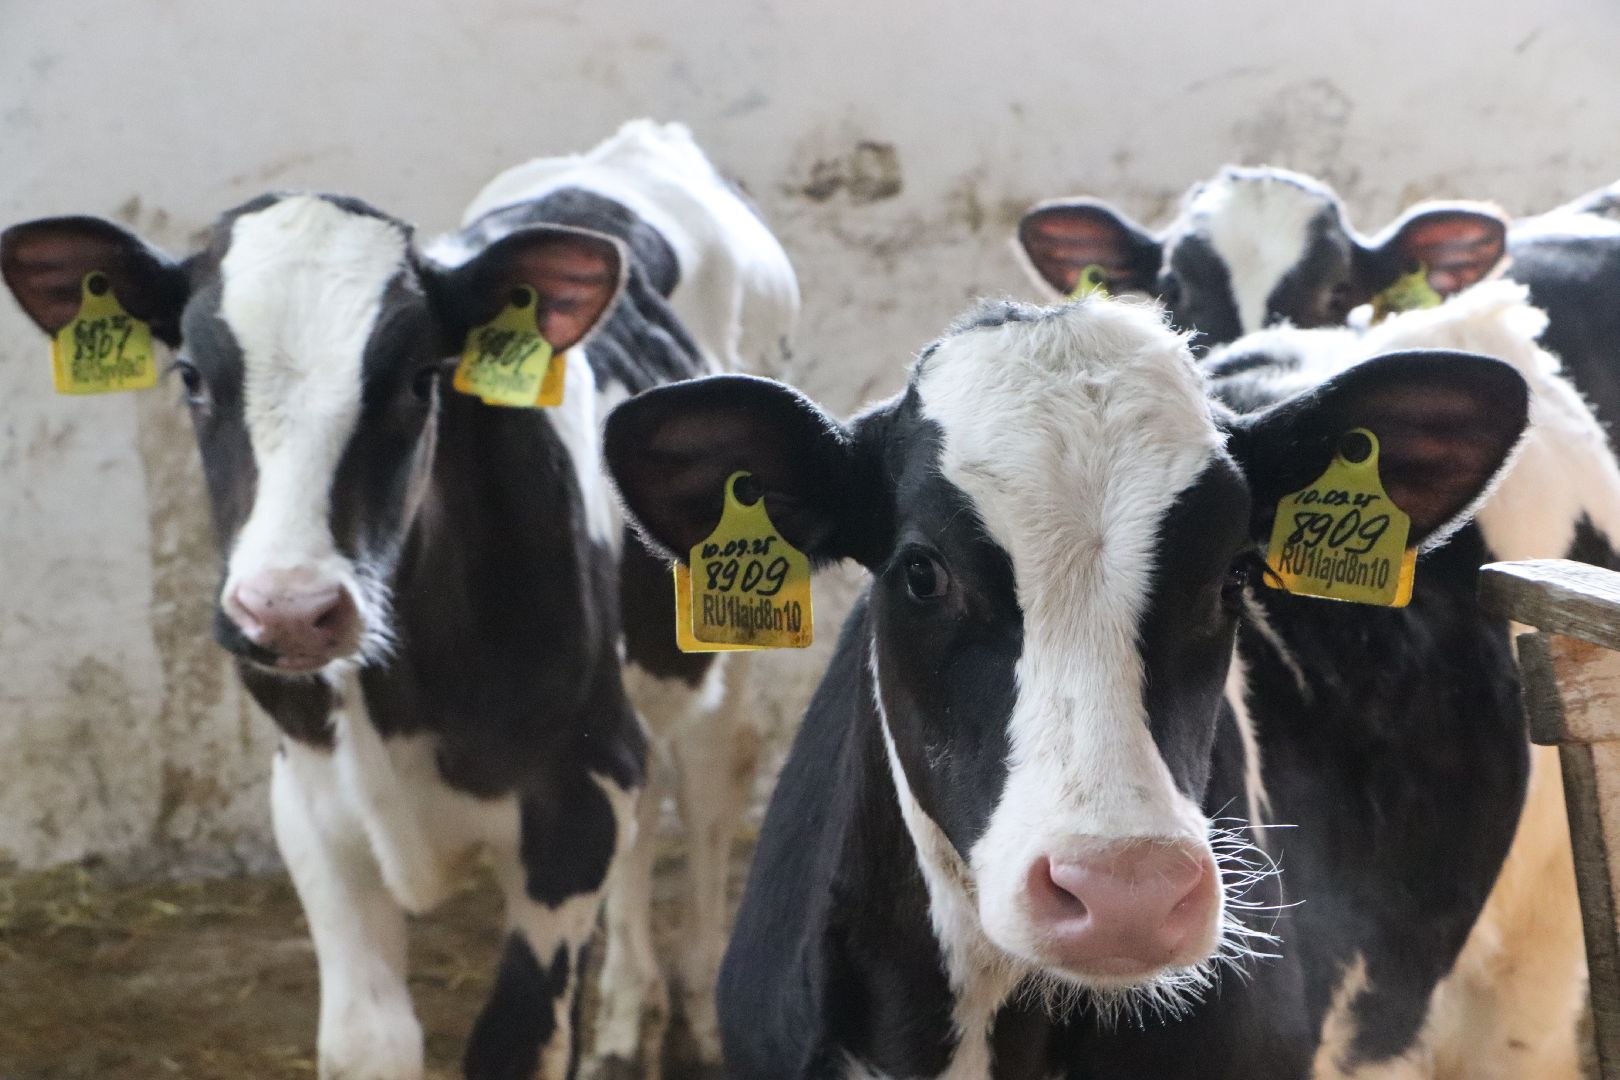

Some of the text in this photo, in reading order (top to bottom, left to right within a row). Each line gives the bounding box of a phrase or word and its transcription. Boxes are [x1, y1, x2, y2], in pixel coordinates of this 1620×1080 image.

[701, 536, 777, 559] 10.09.25
[1287, 508, 1390, 554] 8909
[706, 556, 790, 596] 8909
